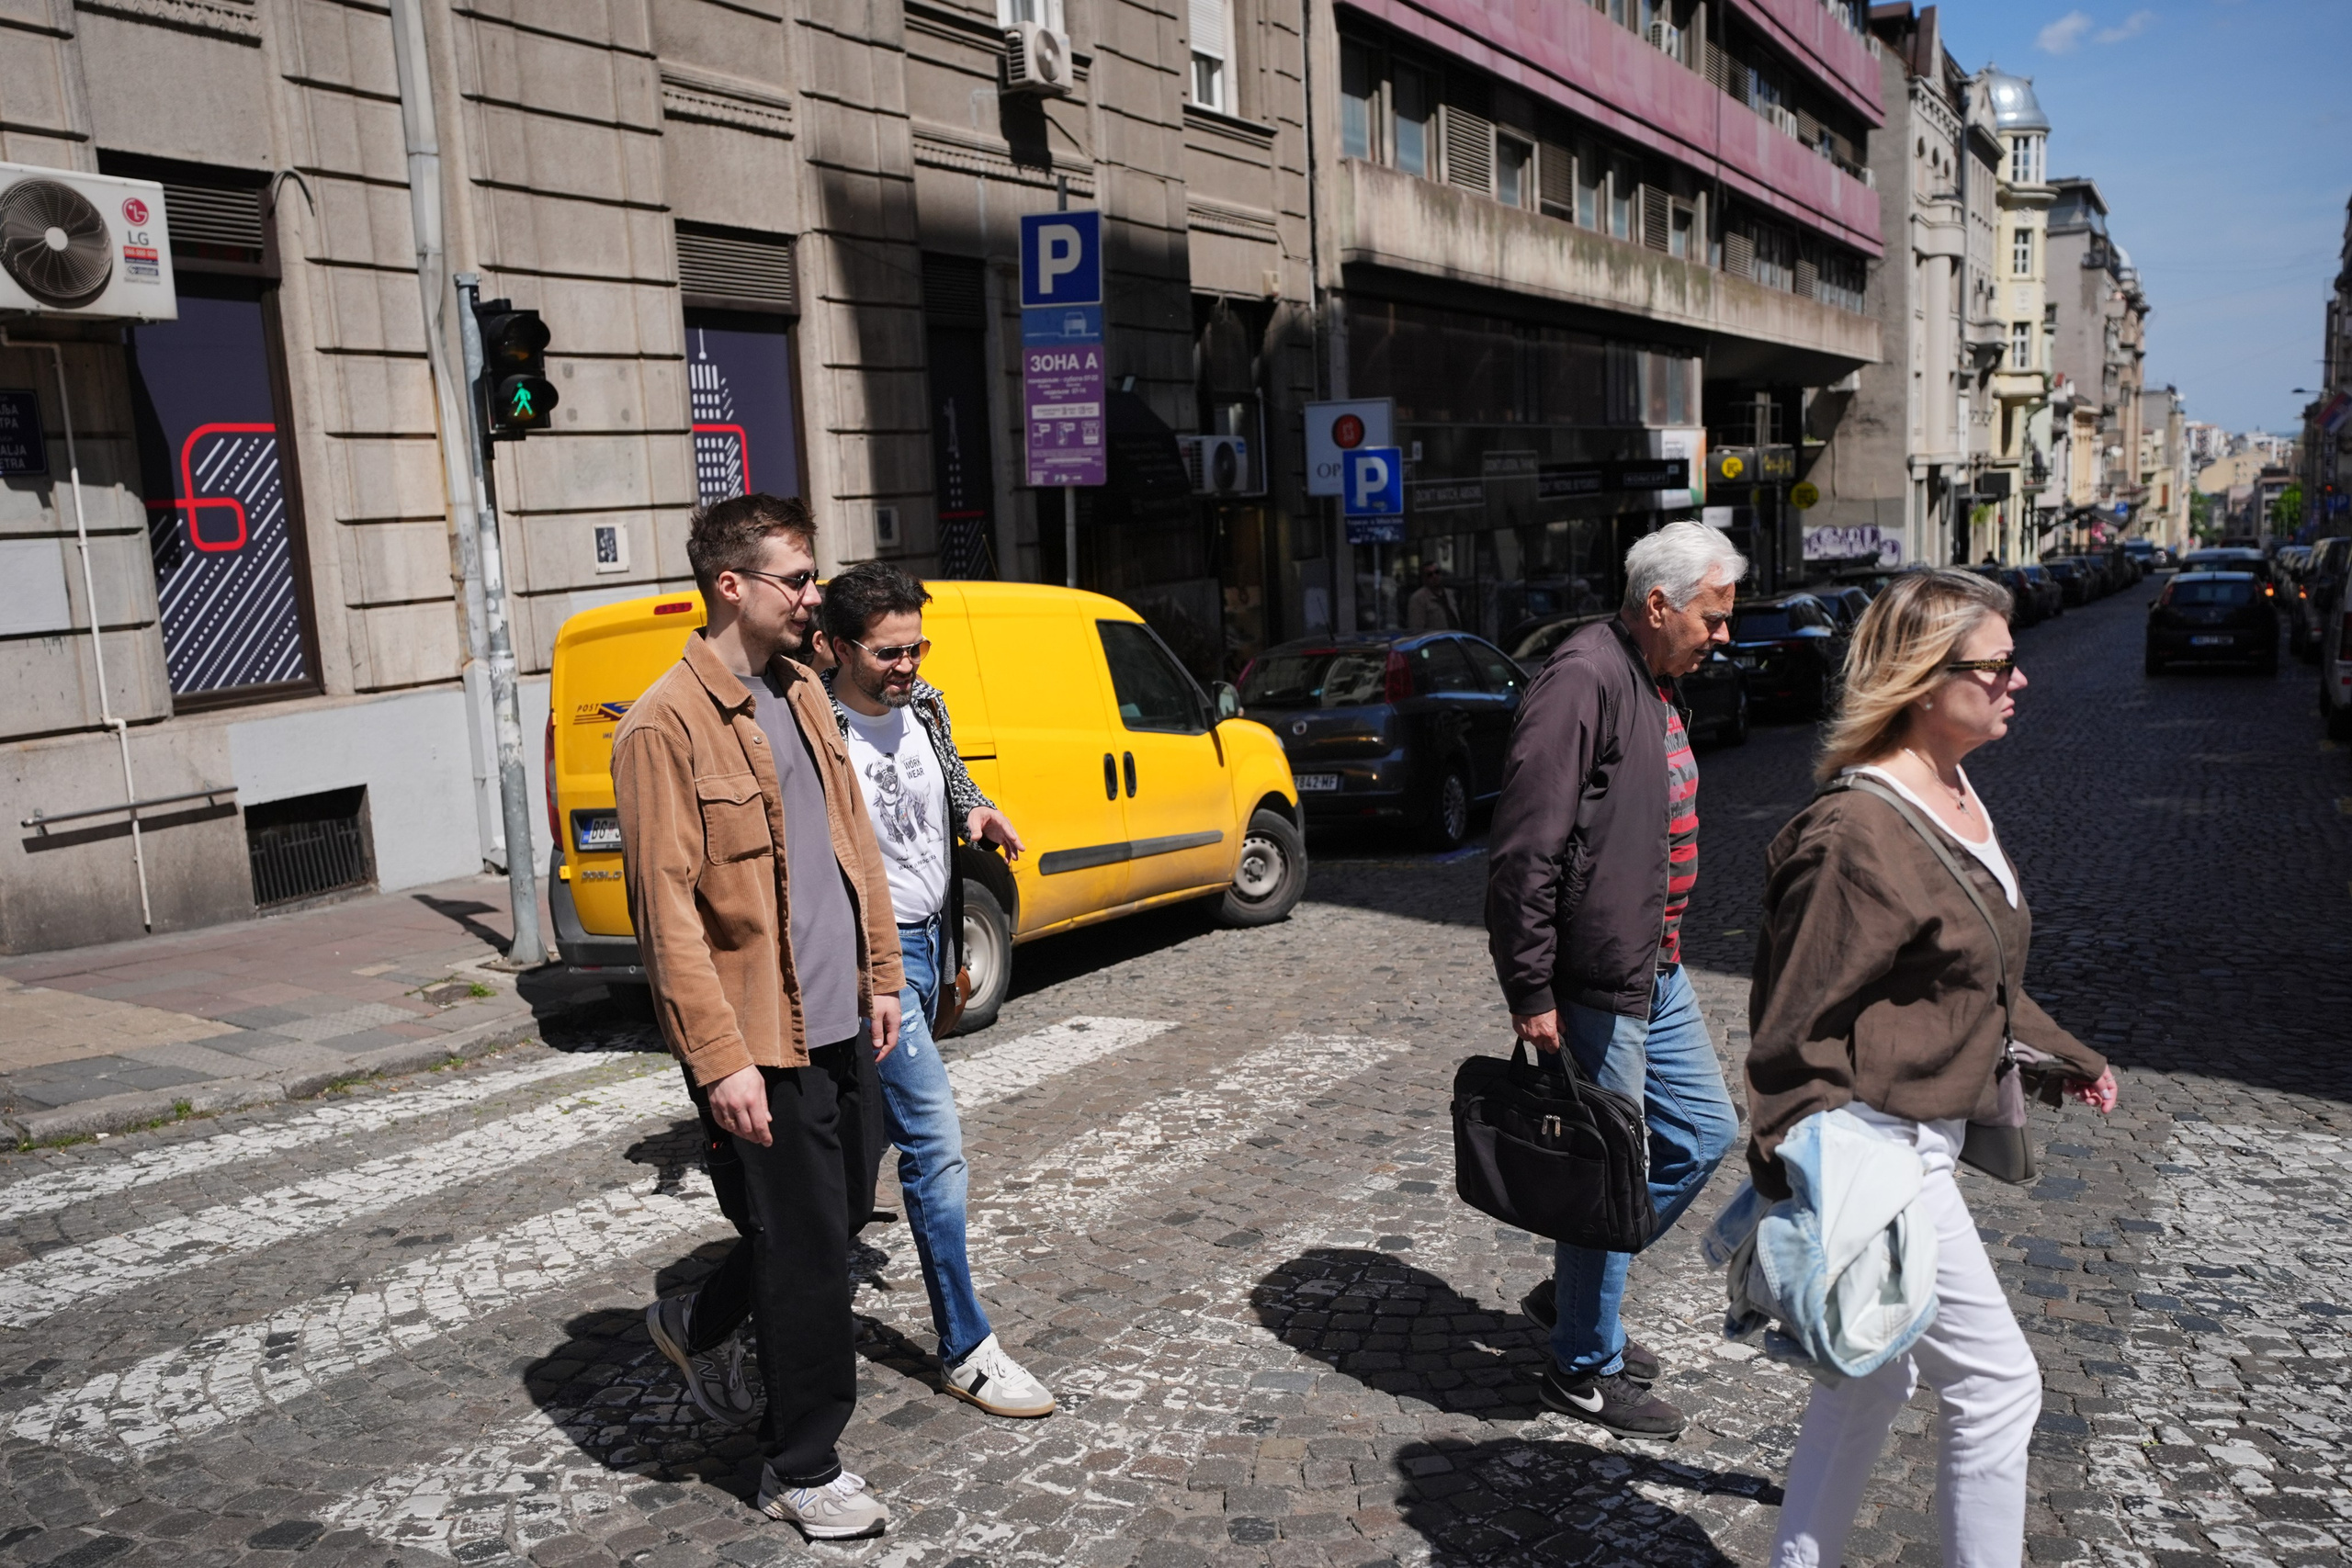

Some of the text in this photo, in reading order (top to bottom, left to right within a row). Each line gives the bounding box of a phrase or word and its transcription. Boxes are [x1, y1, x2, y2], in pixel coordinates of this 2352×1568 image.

[128, 231, 149, 245] LG
[1038, 223, 1082, 295] P
[1030, 352, 1099, 372] ЗОНА А
[1317, 462, 1341, 479] OP
[1355, 457, 1388, 507] P
[577, 704, 599, 713] POST
[903, 758, 922, 771] WORK
[906, 767, 925, 780] WEAR
